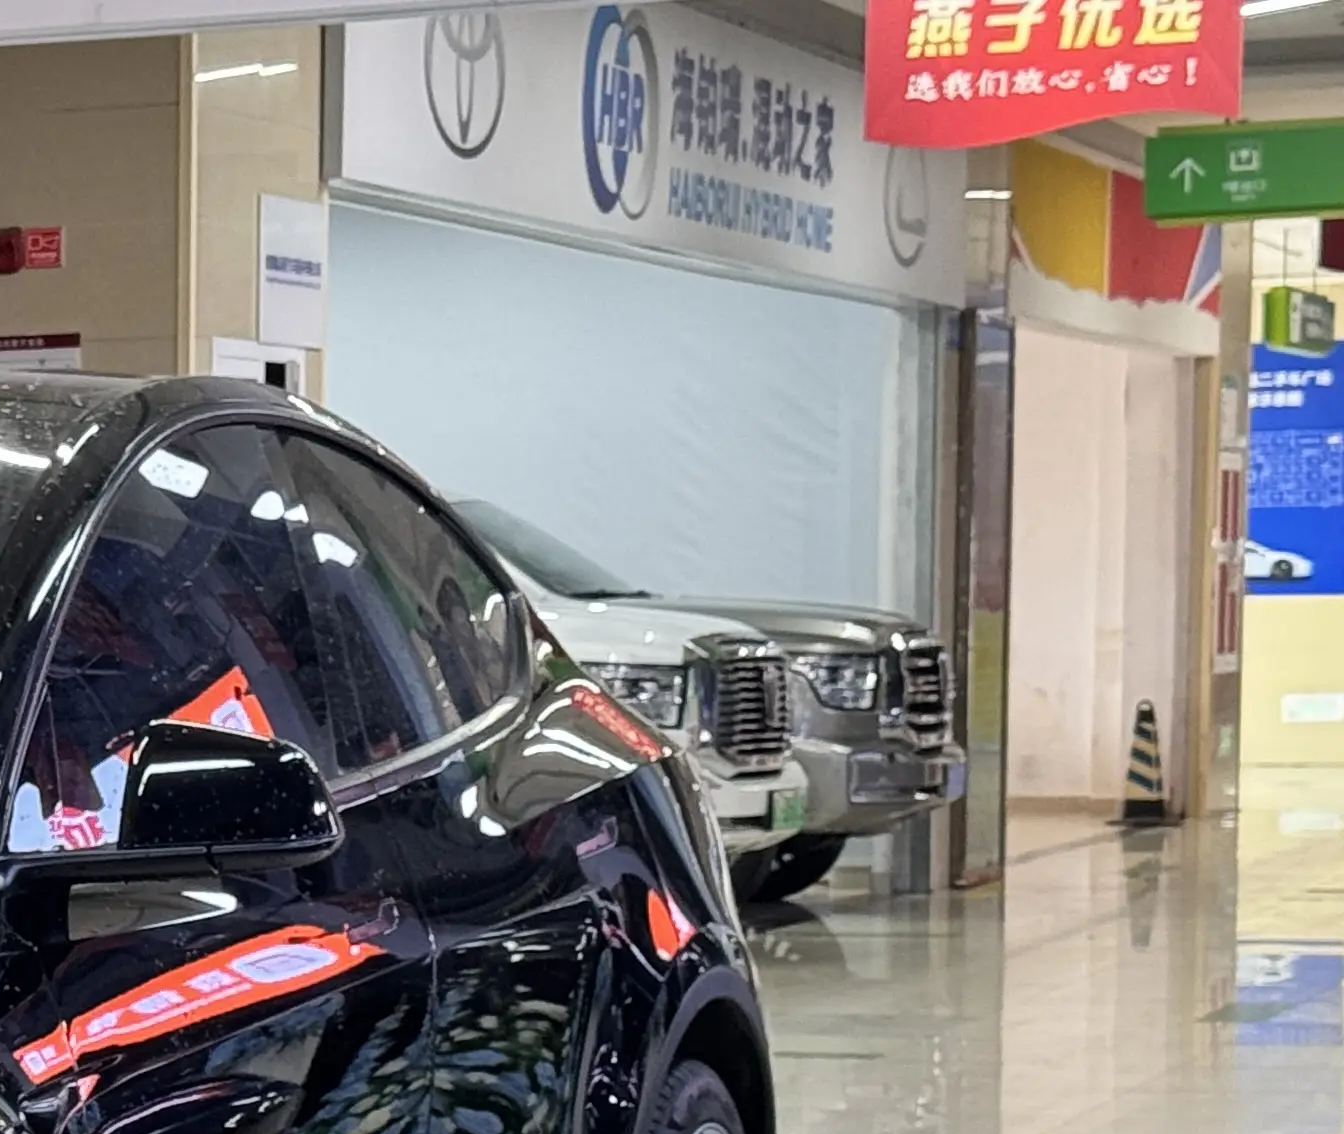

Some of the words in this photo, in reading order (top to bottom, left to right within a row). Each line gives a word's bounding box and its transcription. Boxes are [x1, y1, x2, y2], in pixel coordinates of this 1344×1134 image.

[905, 0, 1204, 58] 燕子优选
[596, 64, 645, 154] HBR
[794, 201, 835, 254] HOME
